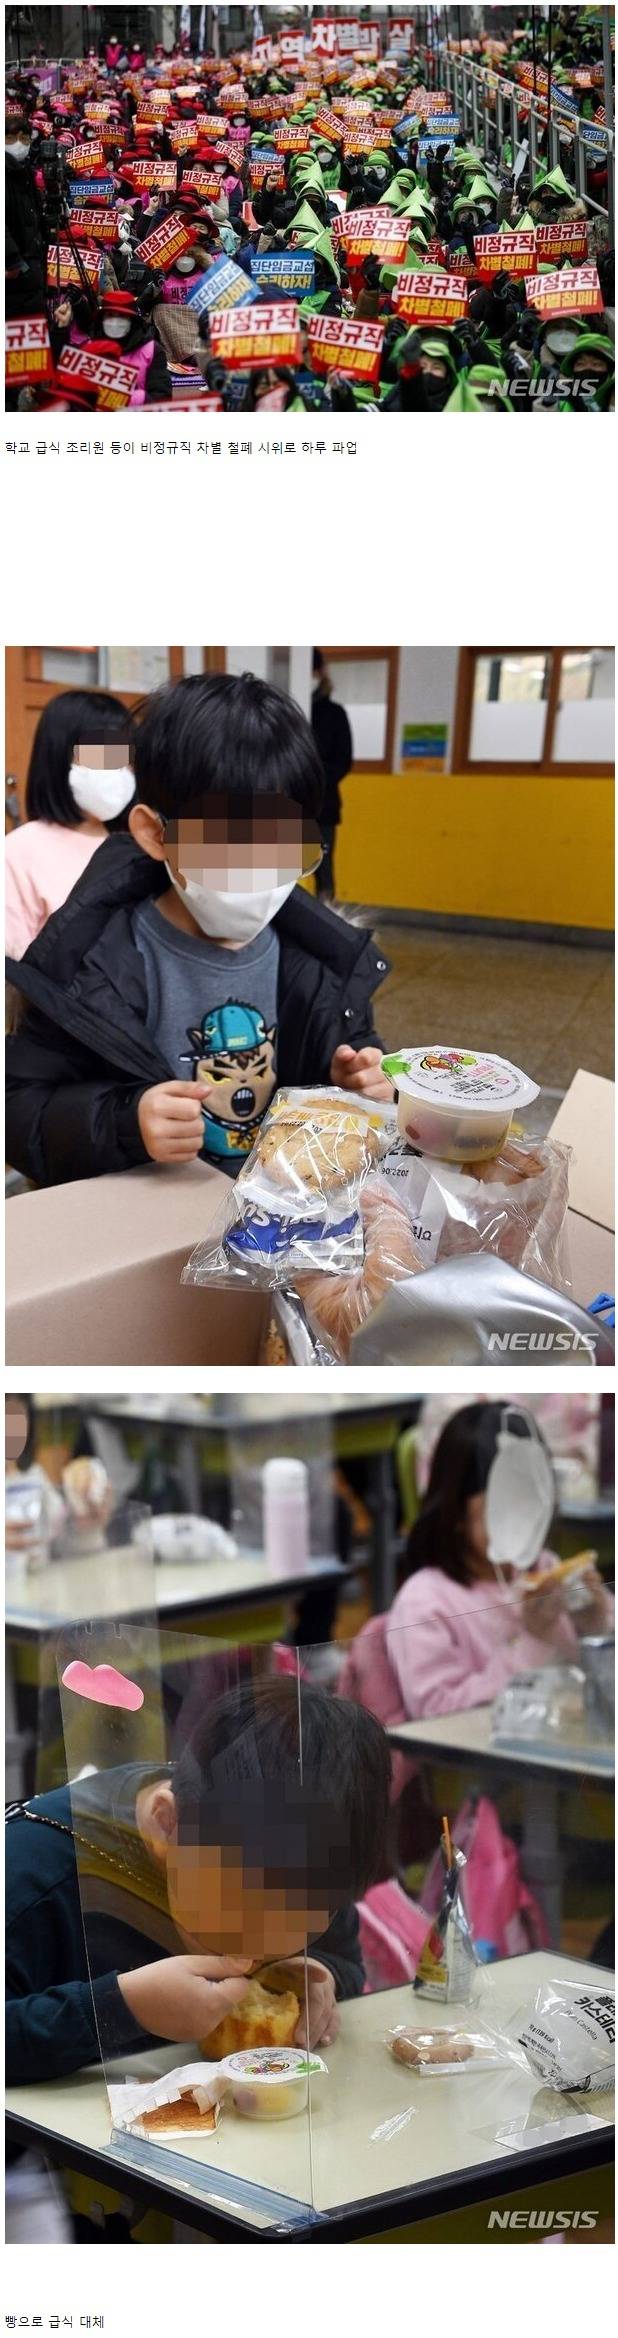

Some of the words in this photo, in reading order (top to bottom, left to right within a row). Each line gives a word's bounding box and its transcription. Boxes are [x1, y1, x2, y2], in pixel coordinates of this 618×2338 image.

[137, 102, 168, 113] 비정규직
[95, 124, 125, 135] 비정규직
[197, 115, 228, 128] 비정규직
[319, 108, 349, 134] 비정규직
[274, 128, 309, 139] 비정규직
[343, 133, 376, 146] 비정규직
[66, 142, 102, 159] 비정규직
[216, 140, 245, 167] 비정규직
[133, 162, 177, 174] 비정규직
[136, 176, 175, 186] 차별철폐!
[183, 171, 221, 185] 비정규직
[71, 210, 119, 224] 비정규직
[135, 216, 183, 260] 비정규직
[349, 220, 410, 238] 비정규직
[536, 223, 587, 241] 비정규직
[150, 229, 190, 268] 차별철폐!
[350, 240, 402, 256] 차별철폐!
[474, 234, 535, 254] 비정규직
[540, 241, 585, 255] 차별철폐!
[251, 260, 314, 273] 집단임금교섭
[479, 254, 533, 271] 차별철폐!
[398, 272, 467, 298] 비정규직
[527, 271, 598, 296] 비정규직
[399, 297, 466, 317] 차별철폐!
[531, 289, 598, 310] 차별철폐!
[210, 307, 298, 334] 비정규직
[309, 317, 384, 348] 비정규직
[216, 334, 297, 358] 차별철폐!
[312, 343, 378, 371] 차별철폐!
[59, 347, 138, 393] 비정규직
